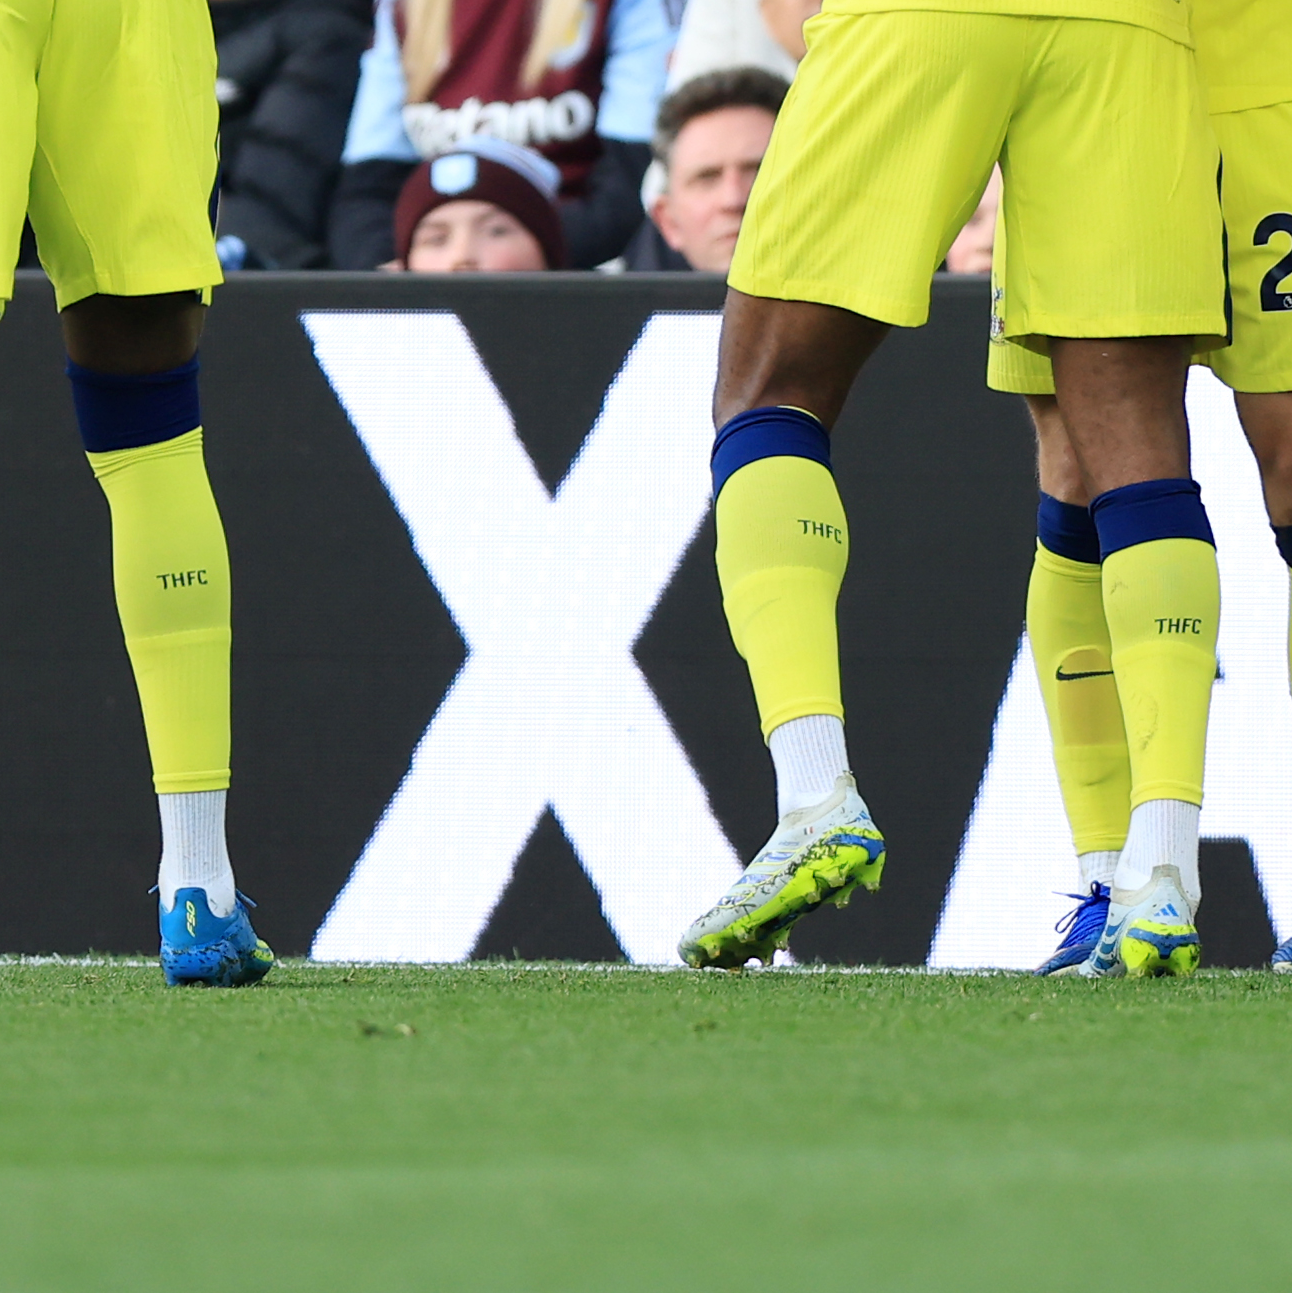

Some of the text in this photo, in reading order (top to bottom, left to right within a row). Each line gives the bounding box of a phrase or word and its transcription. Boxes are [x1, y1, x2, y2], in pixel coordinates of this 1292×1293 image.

[796, 518, 842, 545] THFC
[156, 568, 209, 591] THFC
[1154, 616, 1202, 636] THFC
